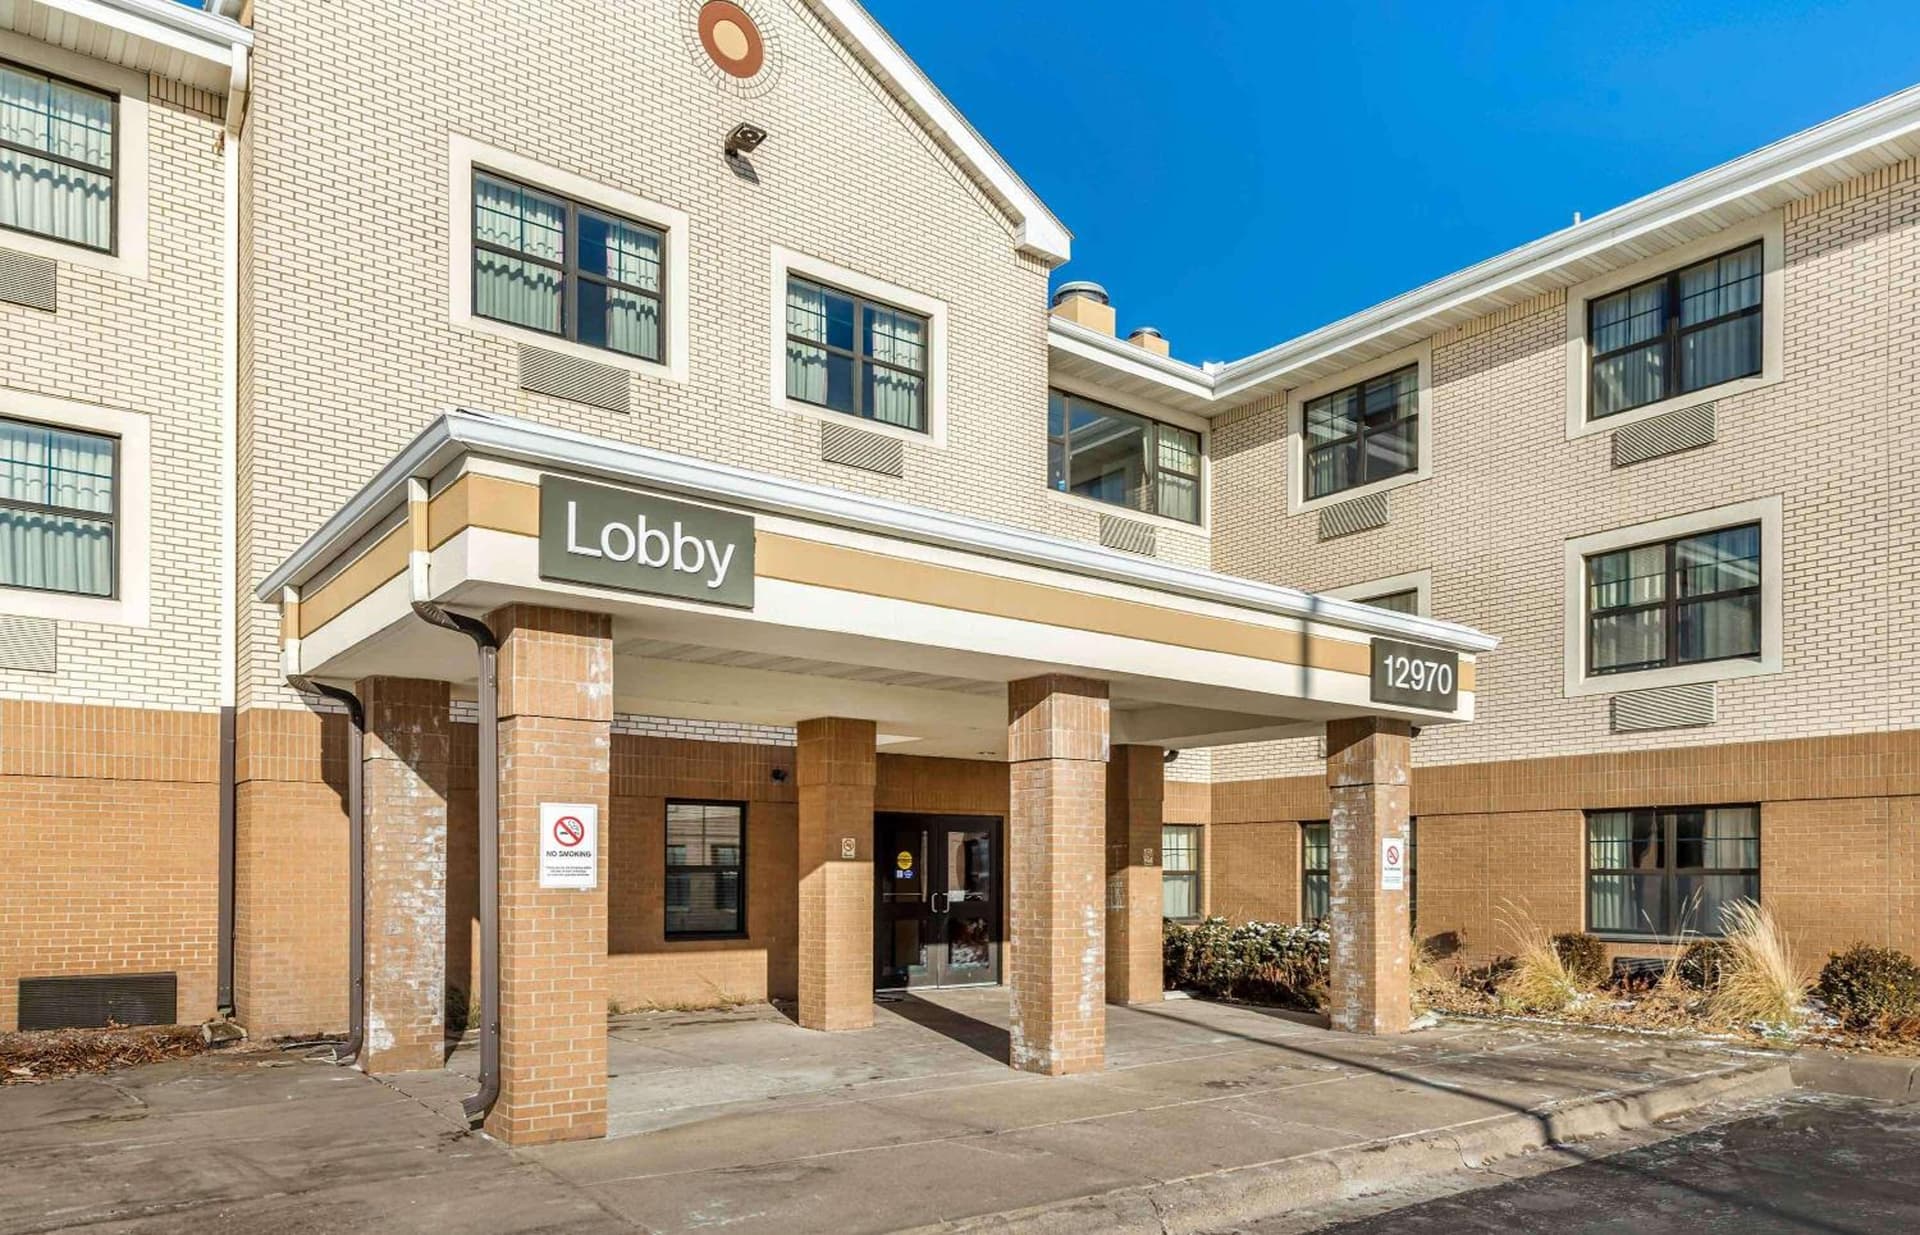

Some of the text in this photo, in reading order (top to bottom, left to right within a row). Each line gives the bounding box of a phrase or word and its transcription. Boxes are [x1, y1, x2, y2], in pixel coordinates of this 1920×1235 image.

[567, 501, 736, 589] Lobby
[1383, 654, 1453, 695] 12970
[545, 850, 592, 858] NO SMOKING
